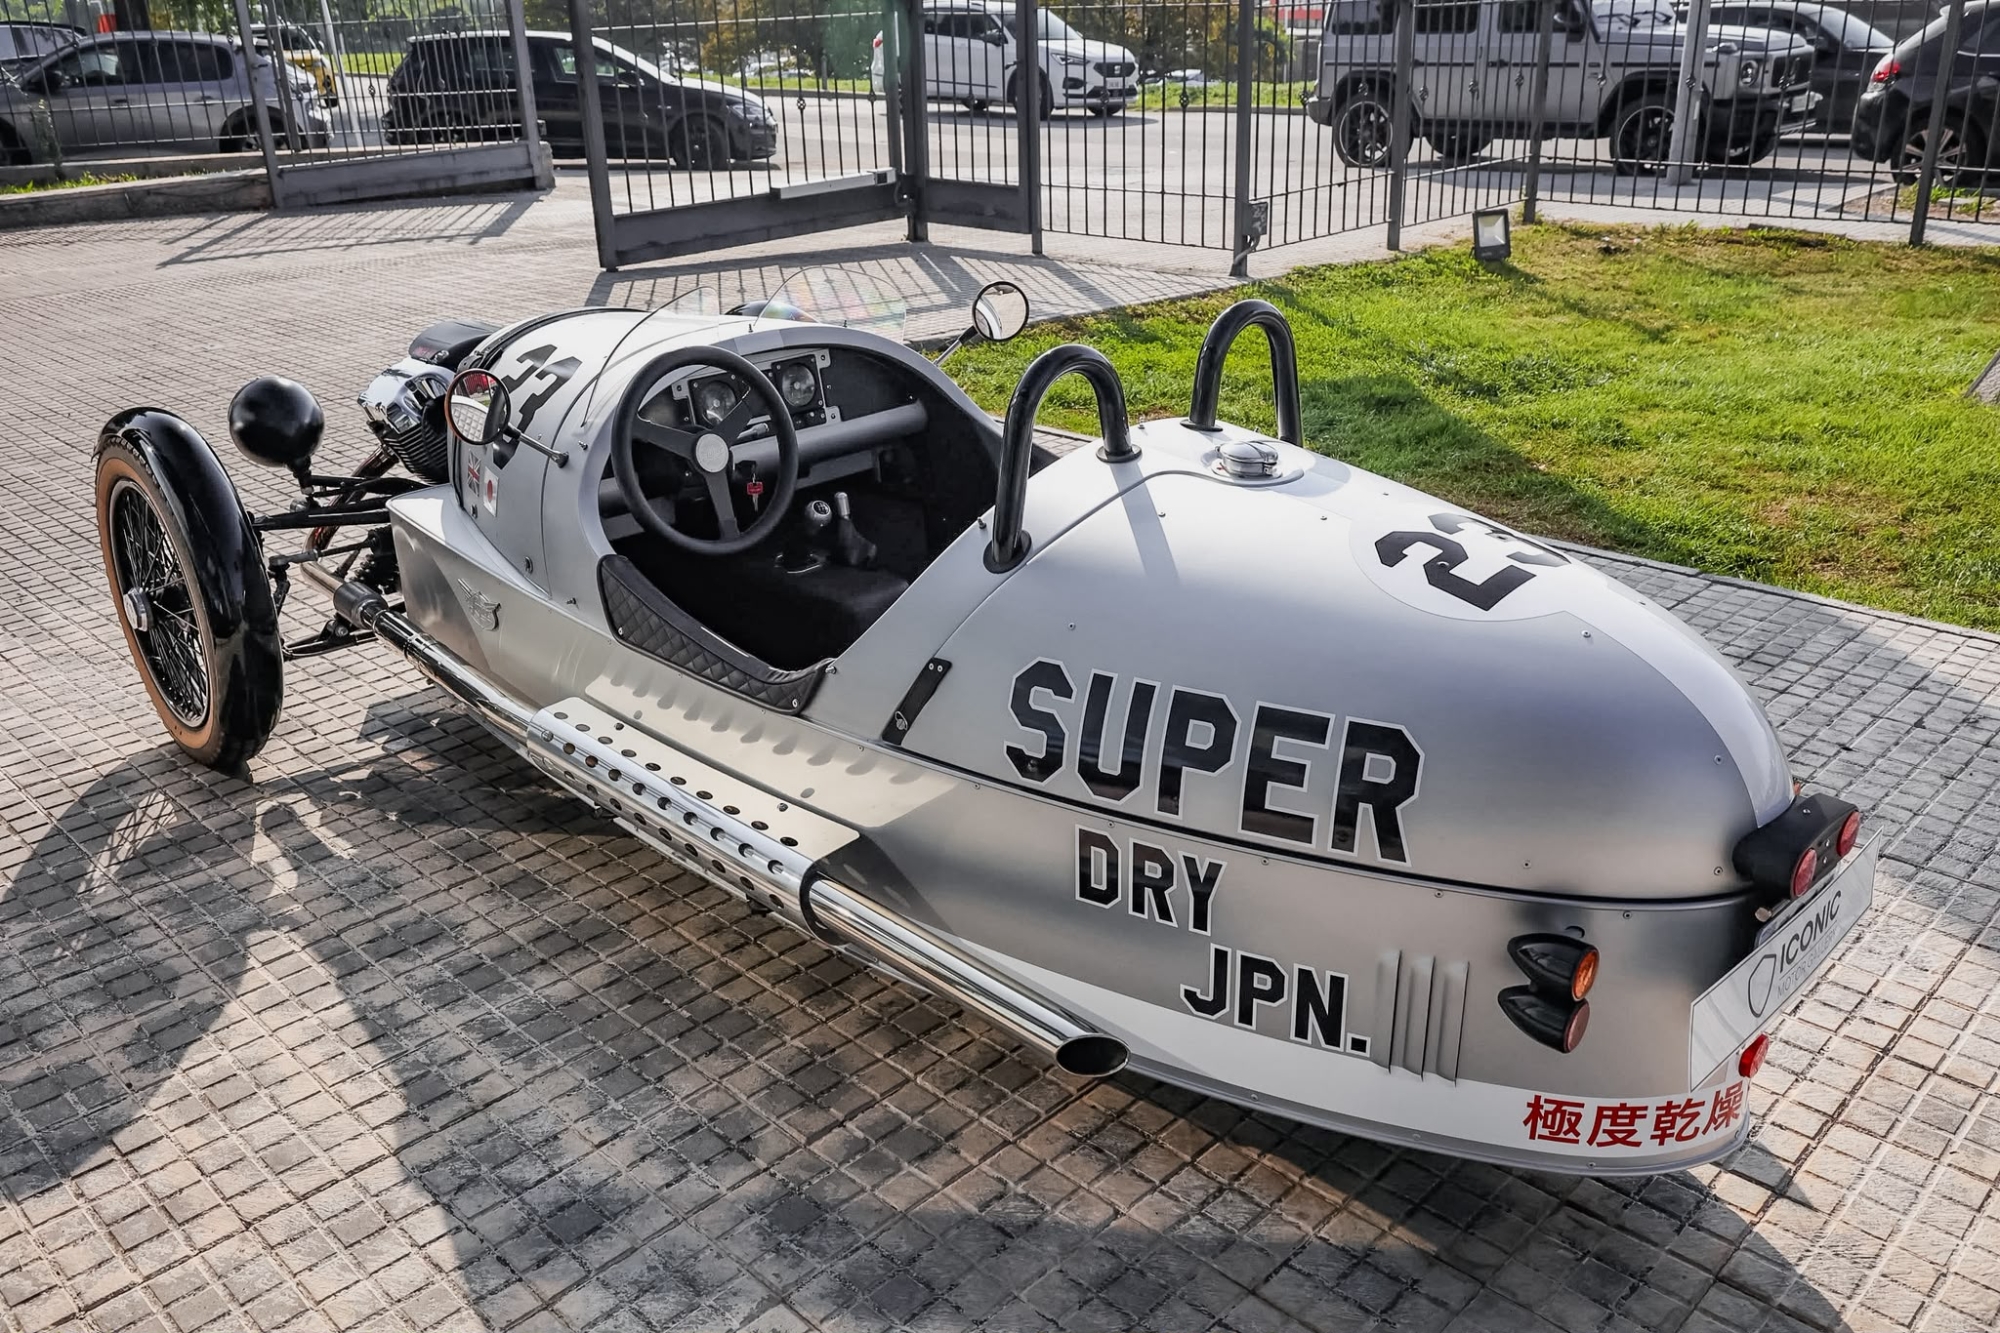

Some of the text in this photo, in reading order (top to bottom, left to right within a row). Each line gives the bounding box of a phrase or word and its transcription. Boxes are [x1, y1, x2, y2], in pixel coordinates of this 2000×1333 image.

[1374, 512, 1572, 611] 23
[1004, 656, 1425, 867] SUPER
[1075, 824, 1227, 936] DRY
[1777, 960, 1807, 999] MOTOR
[1779, 890, 1841, 974] ICONIC
[1180, 943, 1371, 1057] JPN.
[1523, 1080, 1744, 1148] 極度乾燥
